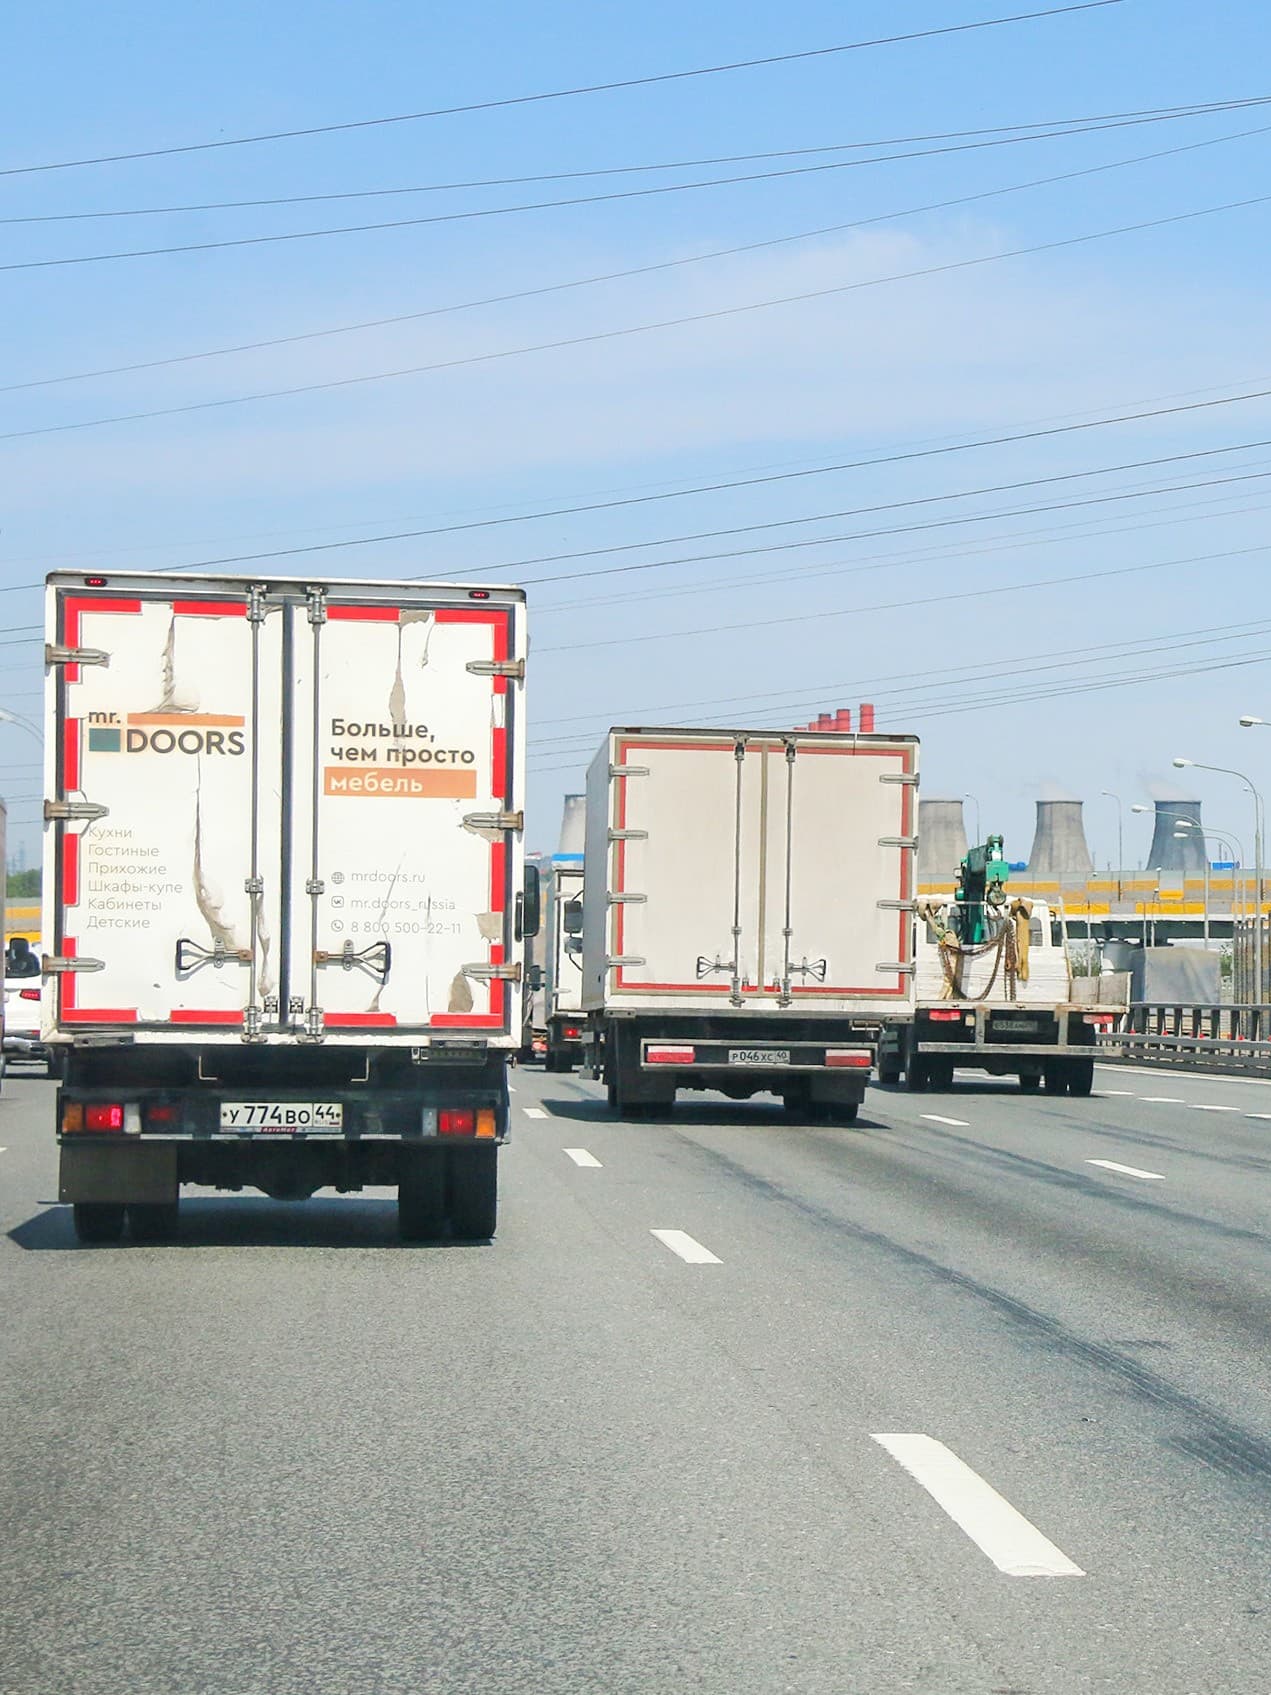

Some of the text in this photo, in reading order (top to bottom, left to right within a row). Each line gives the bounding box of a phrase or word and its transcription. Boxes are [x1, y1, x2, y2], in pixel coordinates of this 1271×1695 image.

[88, 711, 121, 724] mr.
[331, 718, 435, 743] Больше,
[126, 728, 245, 756] DOORS
[330, 747, 475, 767] чем просто
[330, 771, 423, 793] мебель
[88, 826, 132, 840] Кухни
[88, 844, 160, 857] Гостиные
[88, 862, 167, 876] Прихожие
[351, 870, 425, 883] mrdoors.ru
[88, 880, 183, 895] Шкафы-купе
[88, 897, 162, 910] Кабинеты
[87, 916, 150, 929] Детские
[351, 922, 461, 934] 8 800 500-22-11
